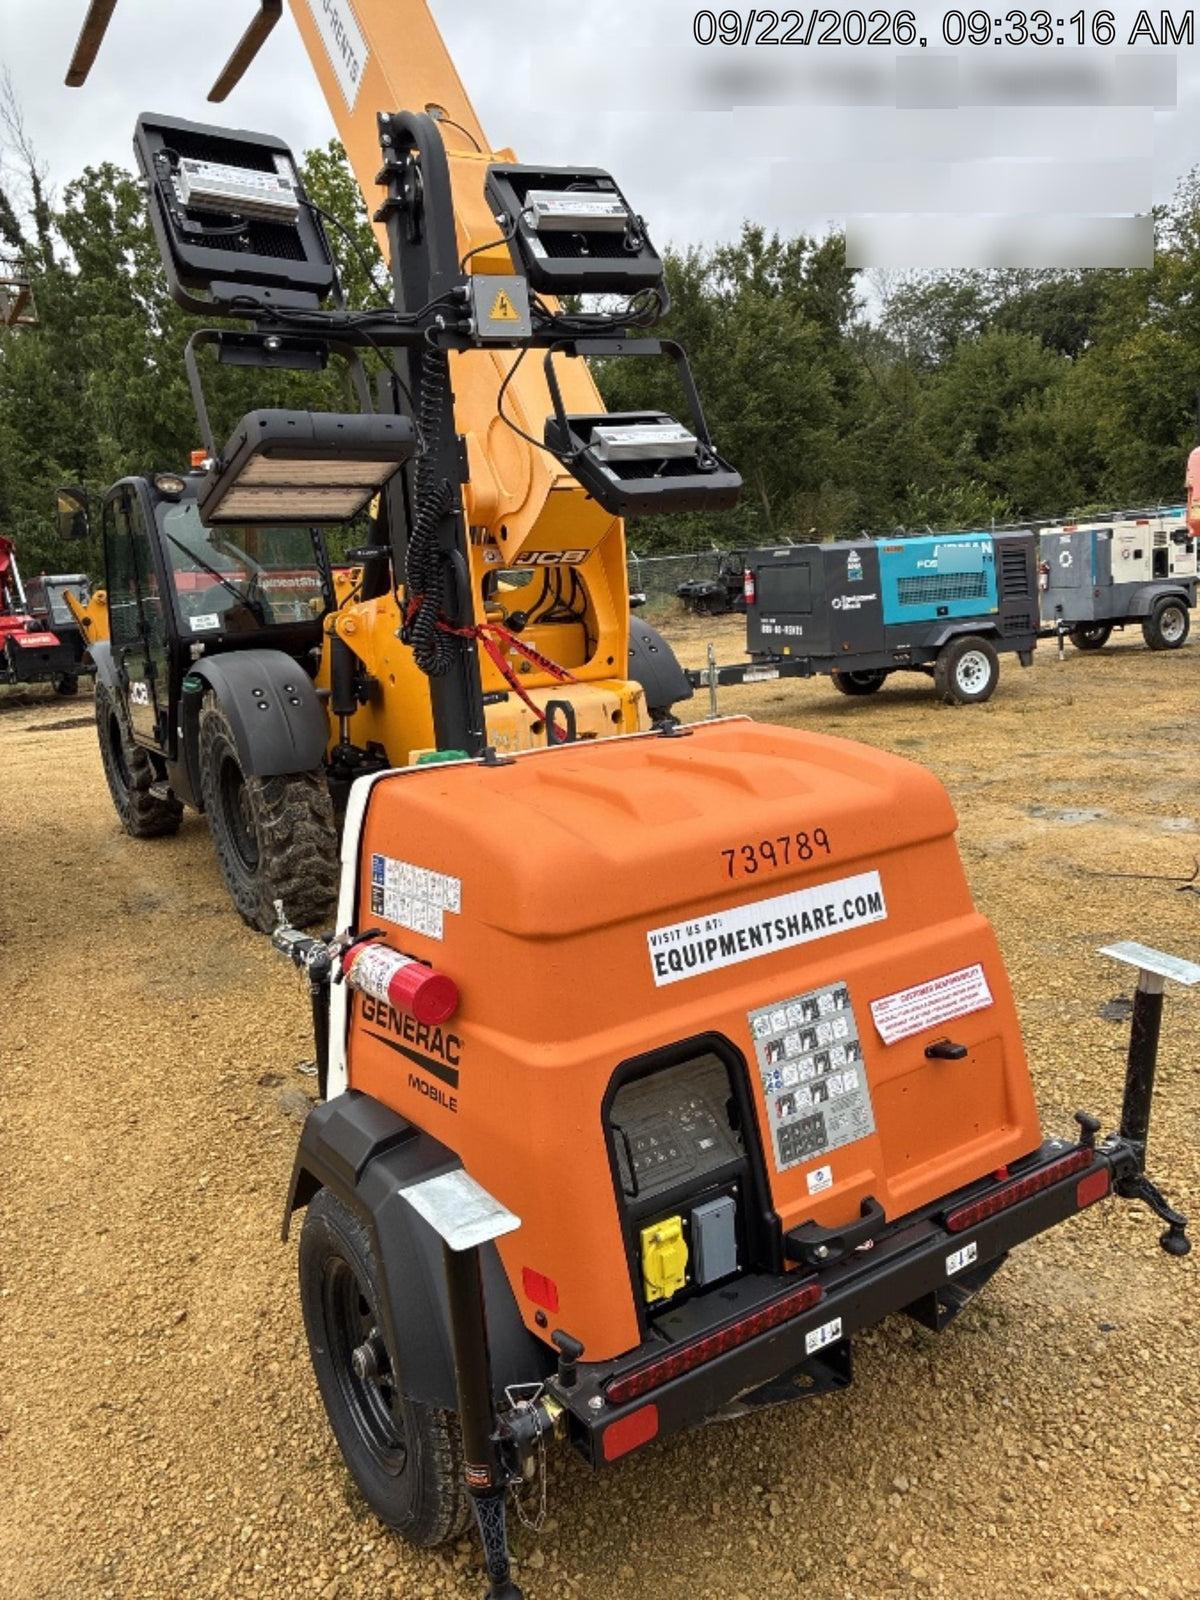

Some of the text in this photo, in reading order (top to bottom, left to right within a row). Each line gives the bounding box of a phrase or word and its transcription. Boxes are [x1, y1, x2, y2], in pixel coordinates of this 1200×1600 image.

[516, 550, 587, 566] JCB
[721, 828, 831, 878] 739789
[650, 918, 723, 947] VISIT US AT:
[653, 891, 883, 977] EQUIPMENTSHARE.COM
[362, 992, 460, 1066] GENERAC
[408, 1073, 459, 1113] MOBILE
